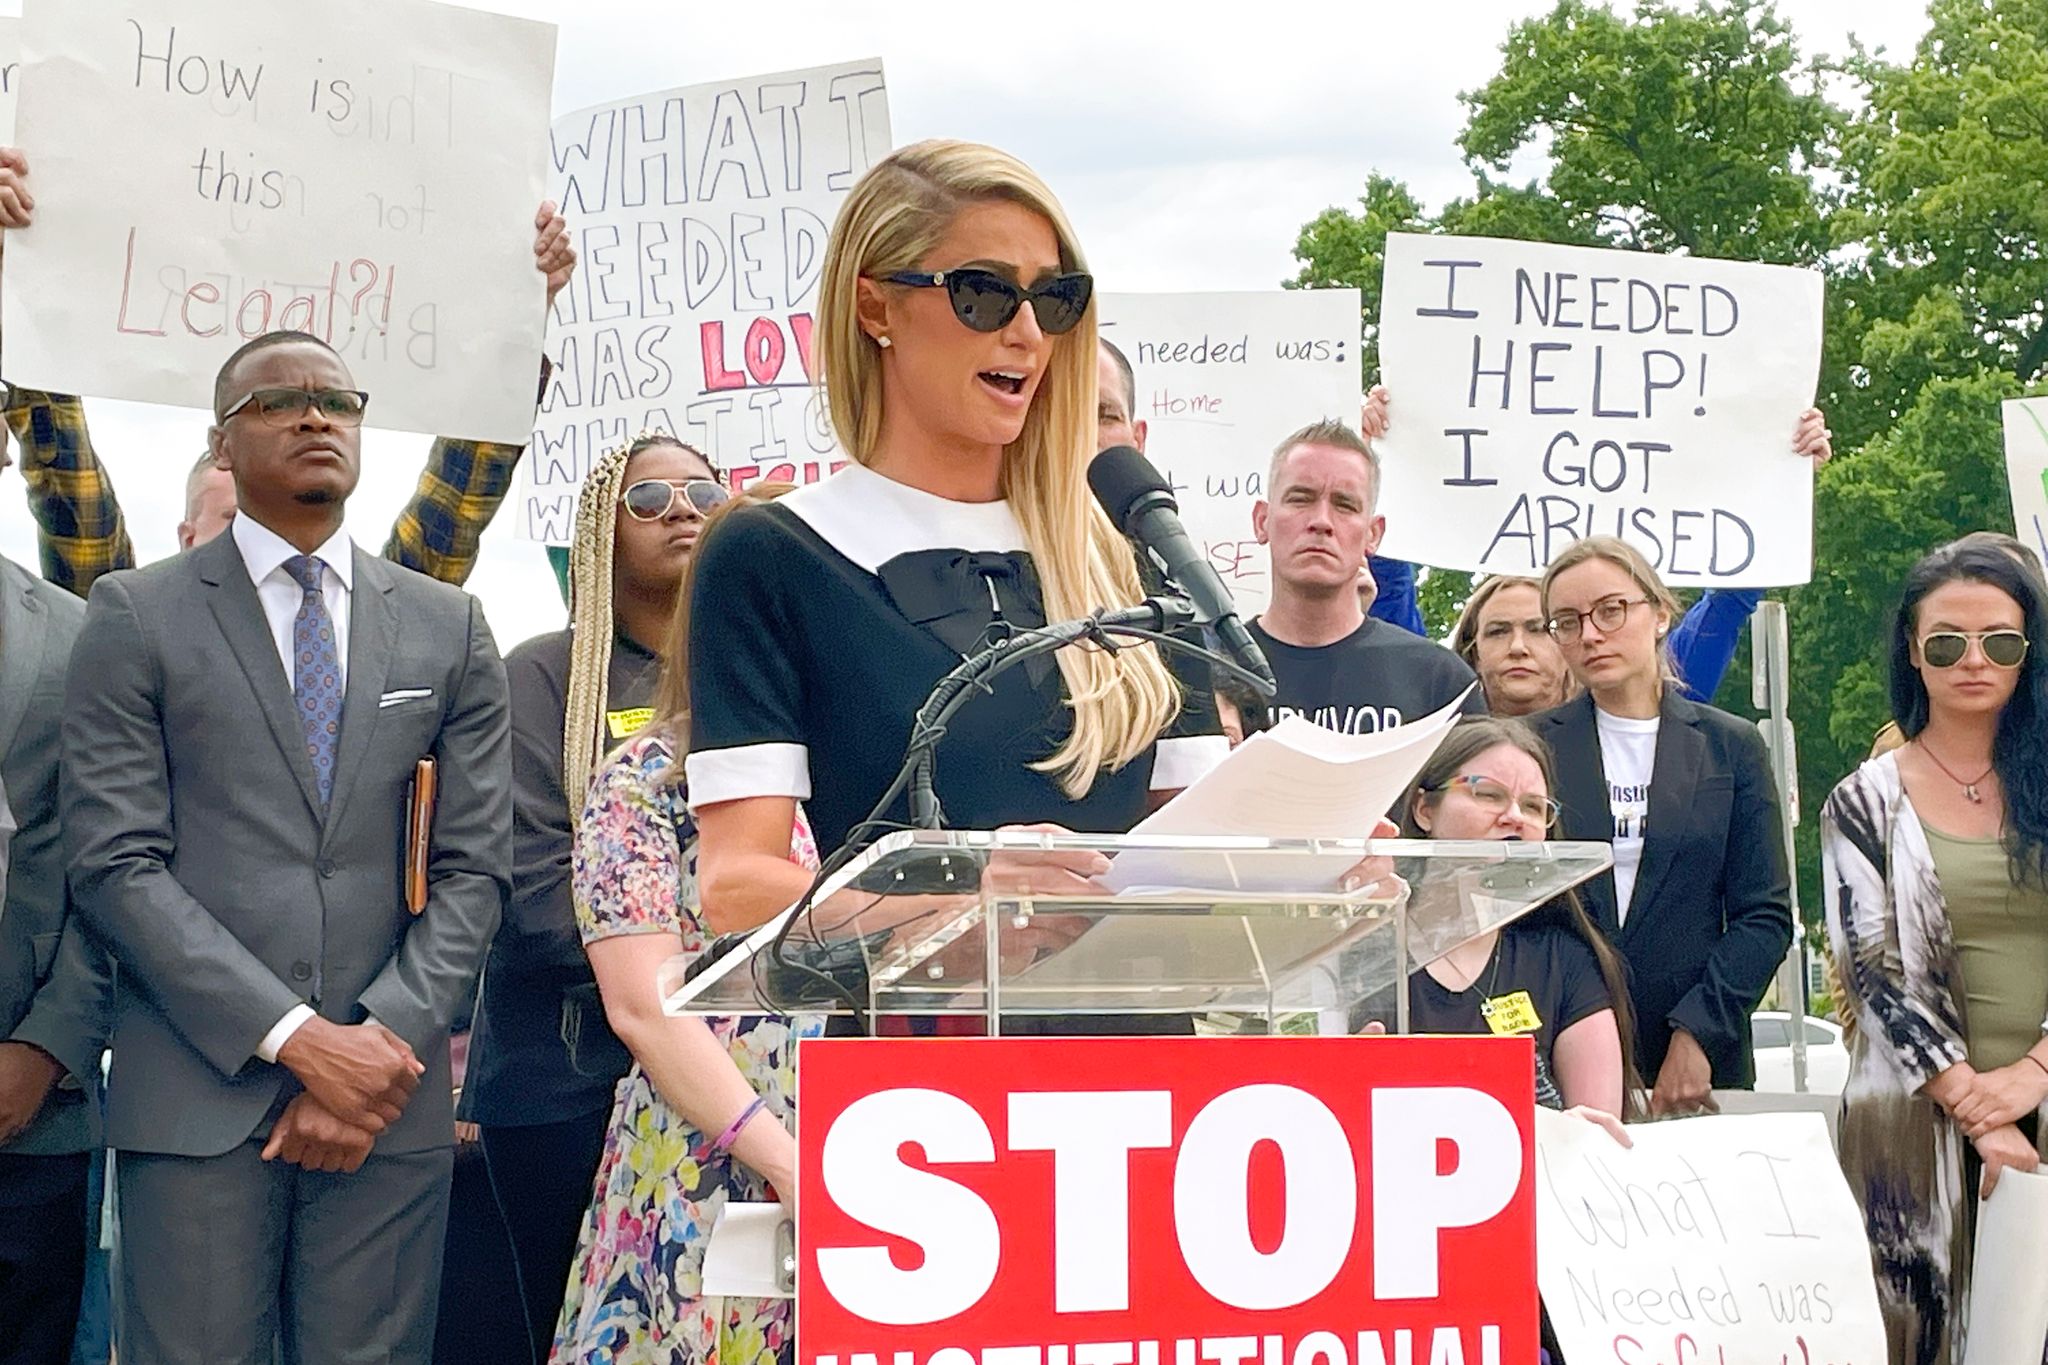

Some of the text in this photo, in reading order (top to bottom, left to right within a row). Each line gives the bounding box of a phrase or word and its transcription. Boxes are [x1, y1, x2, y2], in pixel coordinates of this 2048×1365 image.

[128, 18, 351, 121] How is
[191, 147, 283, 210] this
[550, 70, 885, 214] WHAT I
[1416, 260, 1739, 337] I NEEDED
[1138, 335, 1345, 364] needed was:
[1468, 335, 1708, 418] HELP!
[1152, 389, 1222, 416] Home
[1443, 429, 1674, 493] I GOT
[816, 1083, 1523, 1325] STOP
[1539, 1142, 1821, 1249] What I
[1566, 1264, 1833, 1328] Needed was
